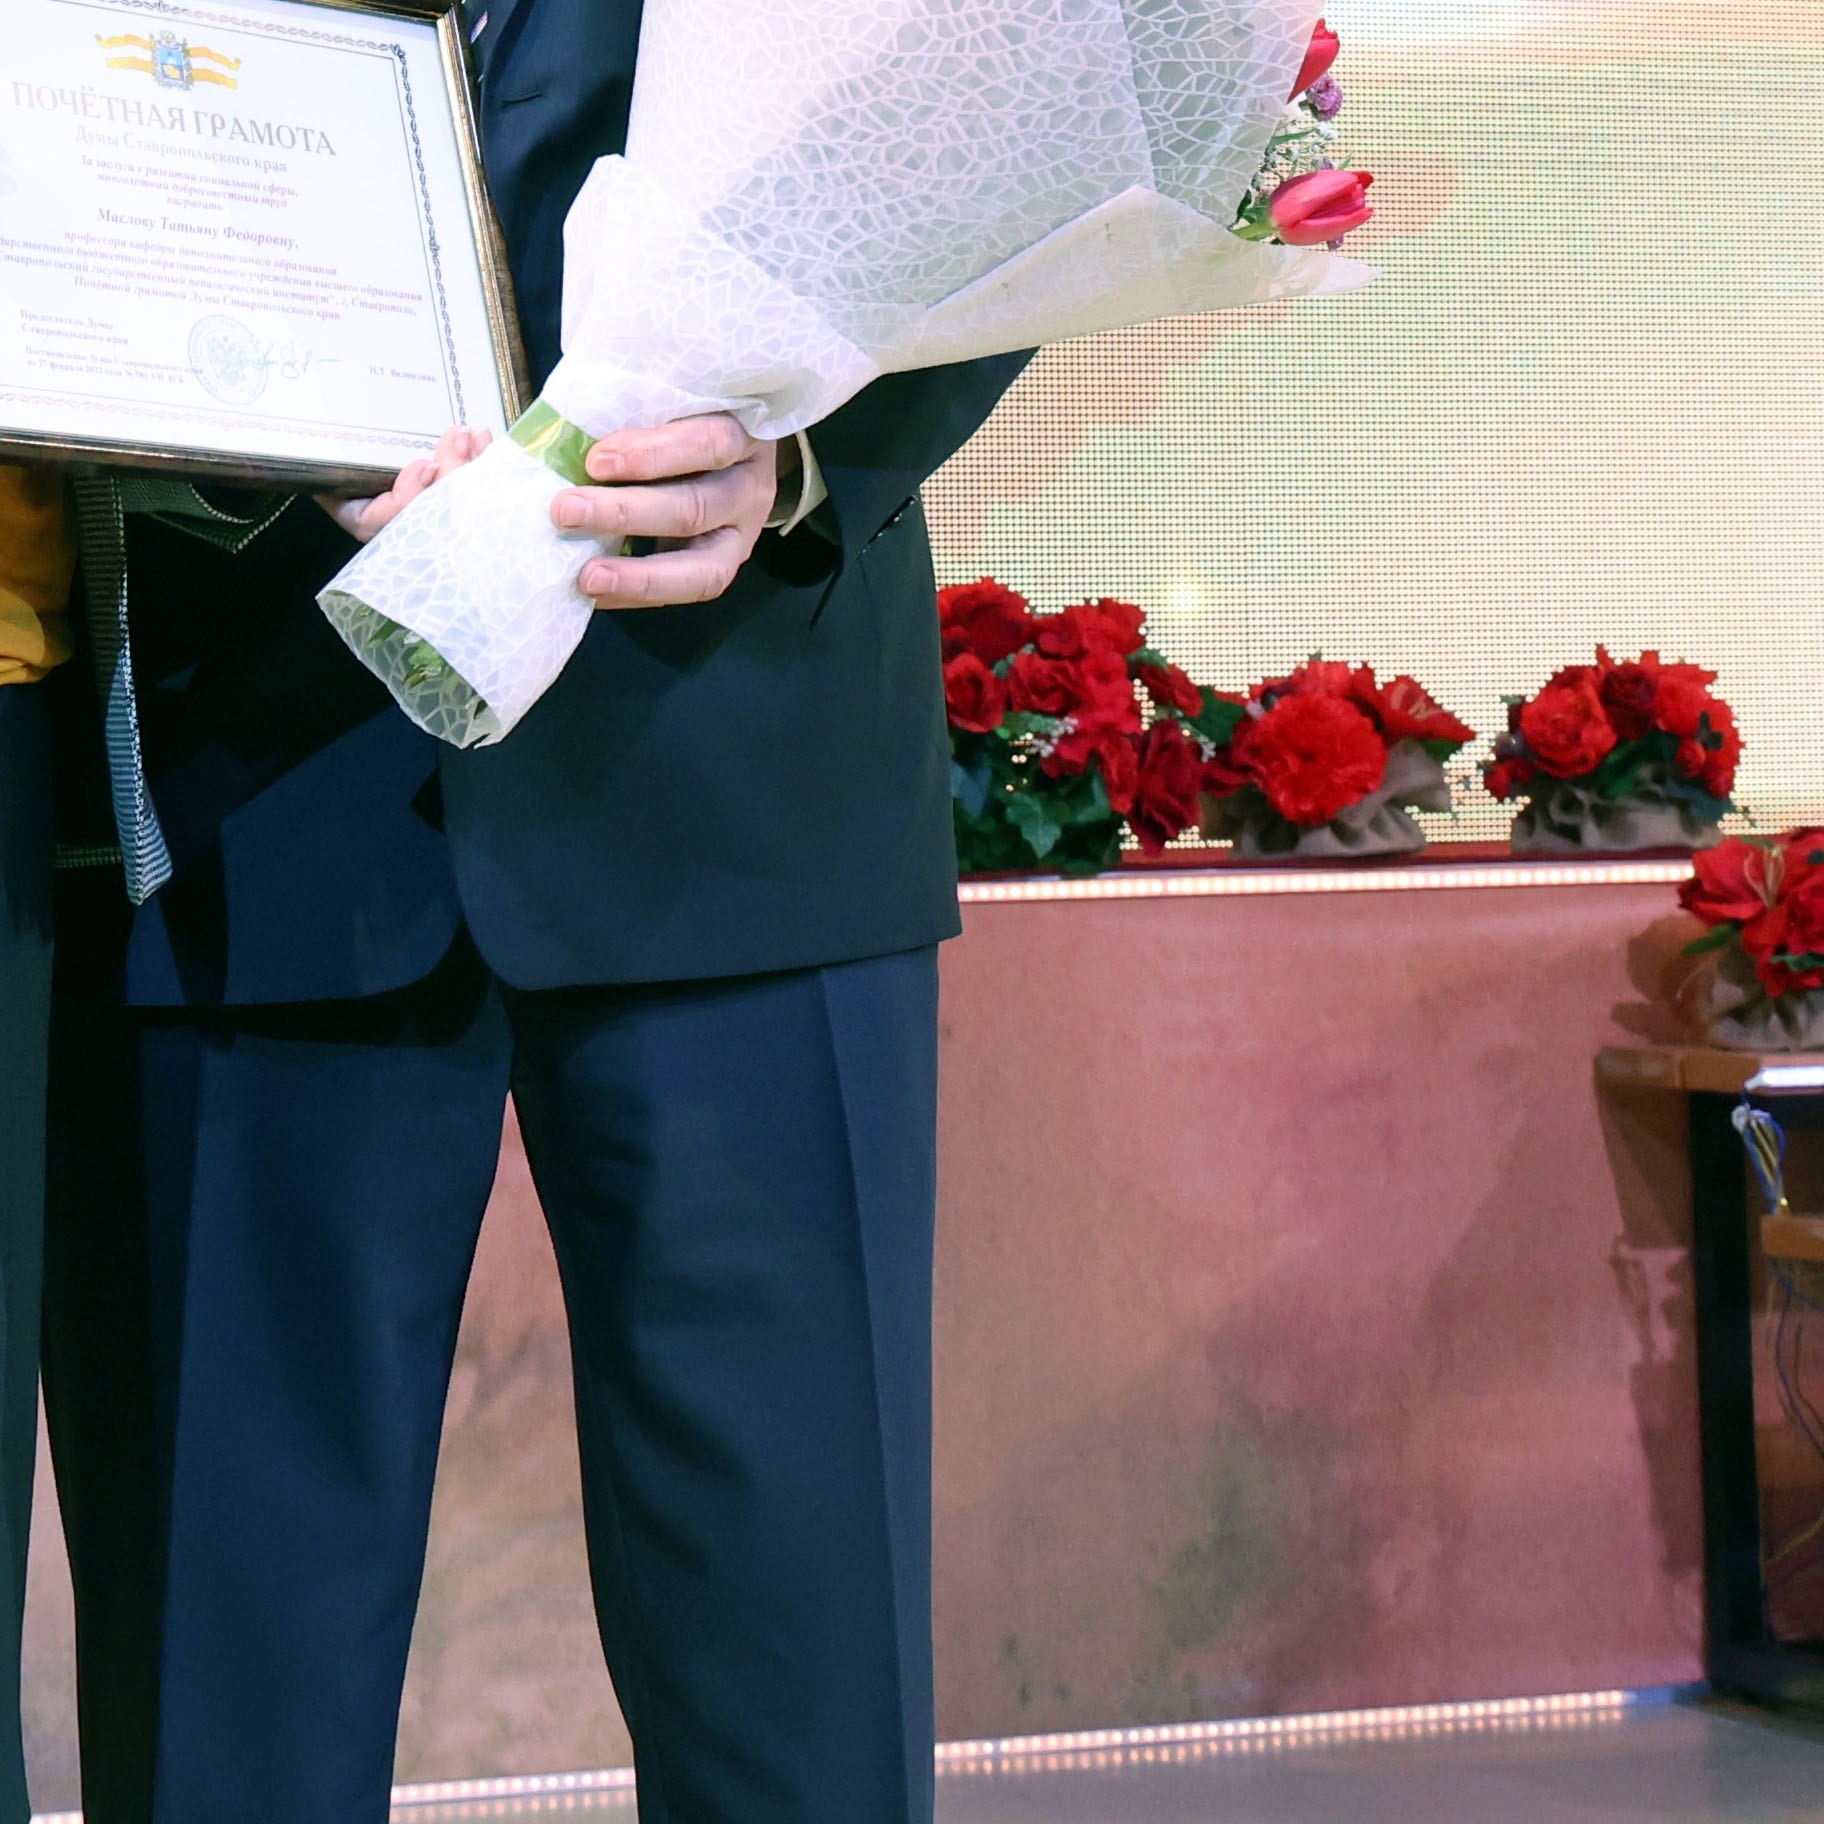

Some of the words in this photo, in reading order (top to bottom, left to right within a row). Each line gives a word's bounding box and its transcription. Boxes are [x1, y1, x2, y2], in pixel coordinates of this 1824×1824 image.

[12, 80, 185, 132] ПОЧЁТНАЯ
[193, 109, 336, 156] ГРАМОТА
[76, 126, 119, 147] Думы
[123, 132, 250, 166] Ставропольского
[254, 158, 287, 173] края
[98, 208, 155, 232] Маслову
[160, 217, 218, 240] Татьяну
[224, 226, 299, 250] Федоровну,
